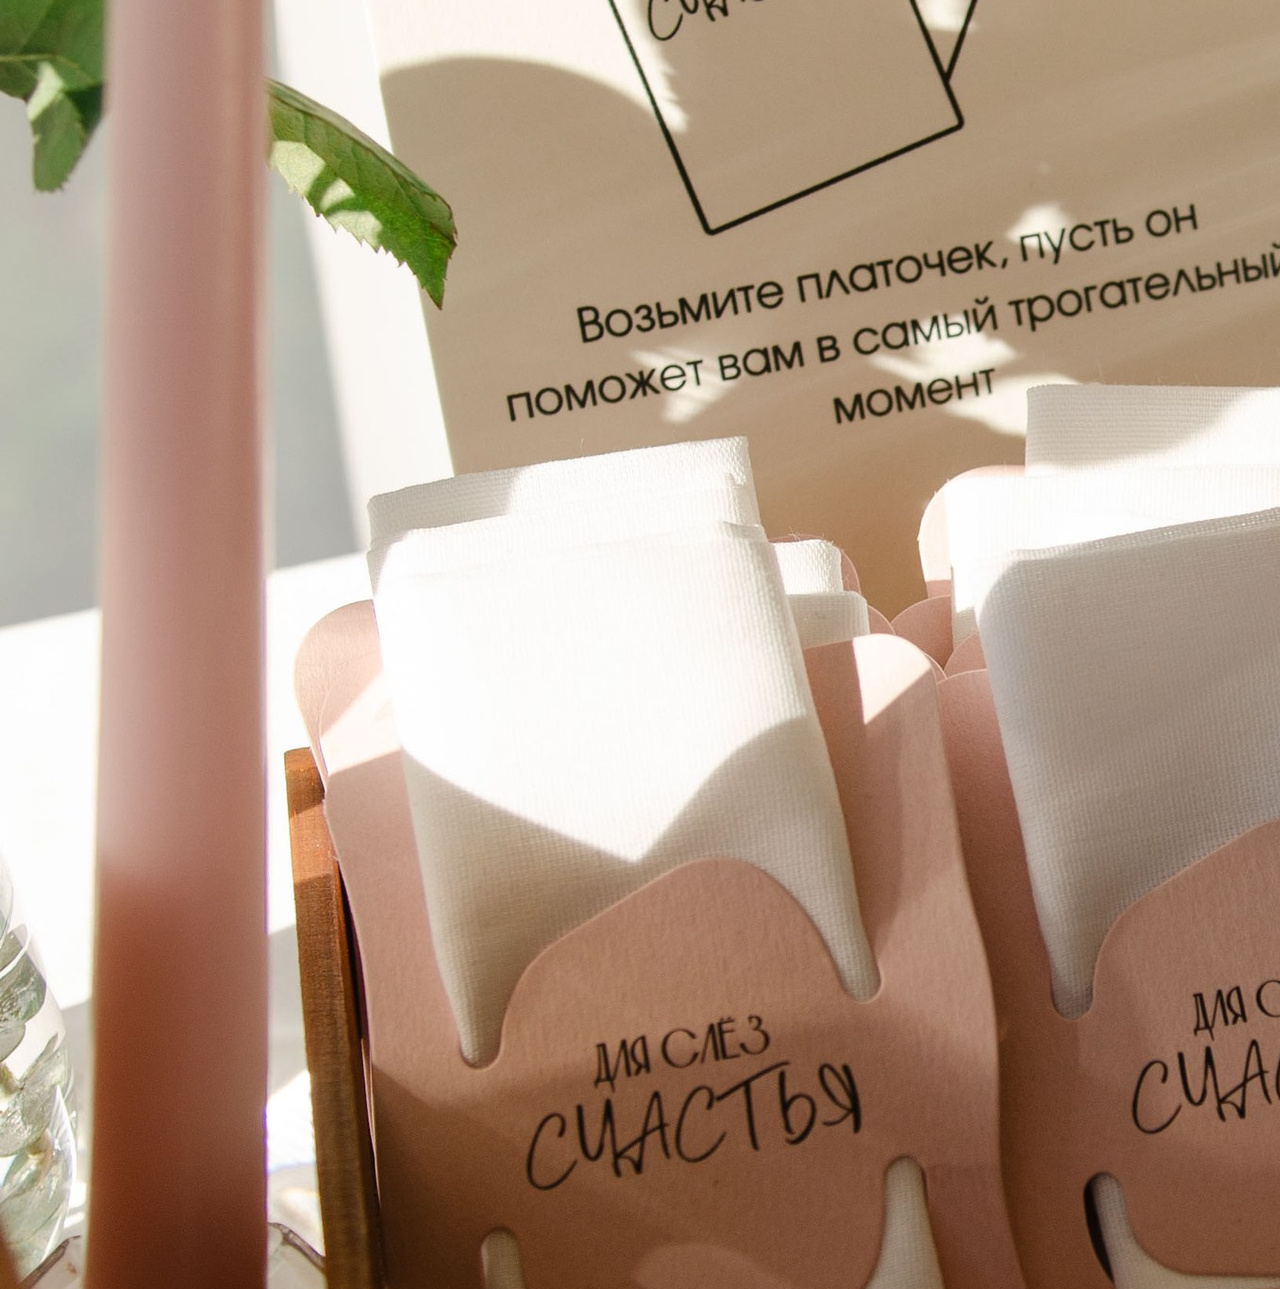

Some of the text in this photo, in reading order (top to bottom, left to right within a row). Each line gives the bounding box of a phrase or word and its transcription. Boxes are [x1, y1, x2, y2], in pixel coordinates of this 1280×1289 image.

[577, 203, 1199, 344] Возьмите платочек, пусть он
[506, 358, 703, 423] поможет
[718, 340, 805, 382] вам
[816, 334, 841, 364] в
[853, 297, 998, 356] самый
[832, 368, 997, 426] момент
[593, 1014, 770, 1093] ДЛЯ СЛЁЗ
[1192, 985, 1248, 1041] ДЛЯ
[526, 1060, 863, 1191] СЧАСТЬЯ
